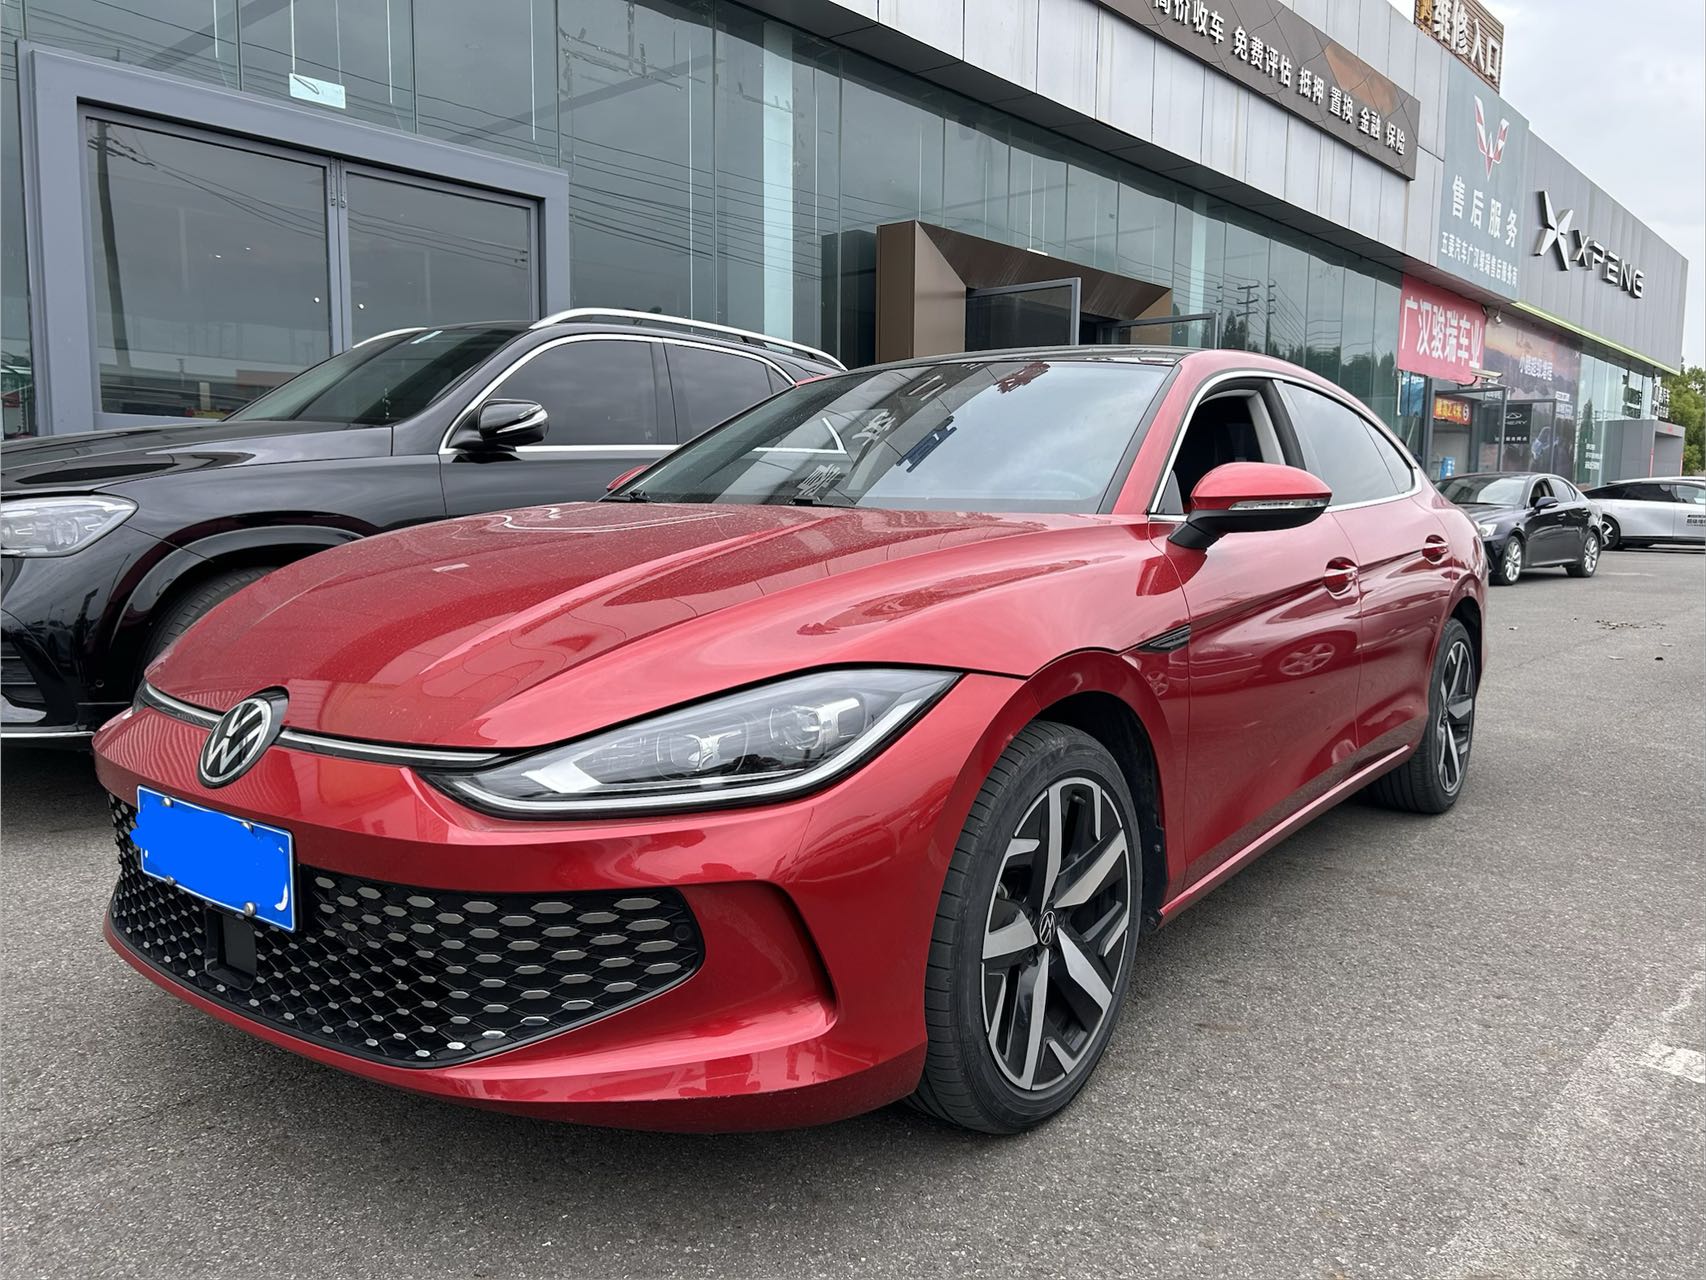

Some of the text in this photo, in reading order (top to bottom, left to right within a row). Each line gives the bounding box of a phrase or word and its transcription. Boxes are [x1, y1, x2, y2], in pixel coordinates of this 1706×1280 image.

[1433, 0, 1500, 82] 维修入口
[1233, 26, 1292, 88] 免费评估
[1299, 67, 1325, 105] 抵押
[1328, 86, 1354, 124] 置换
[1358, 106, 1381, 141] 金融
[1386, 121, 1405, 155] 保险
[1452, 174, 1518, 248] 售后服务
[1571, 229, 1645, 299] XPENG
[1401, 296, 1483, 369] 广汉骏瑞车业
